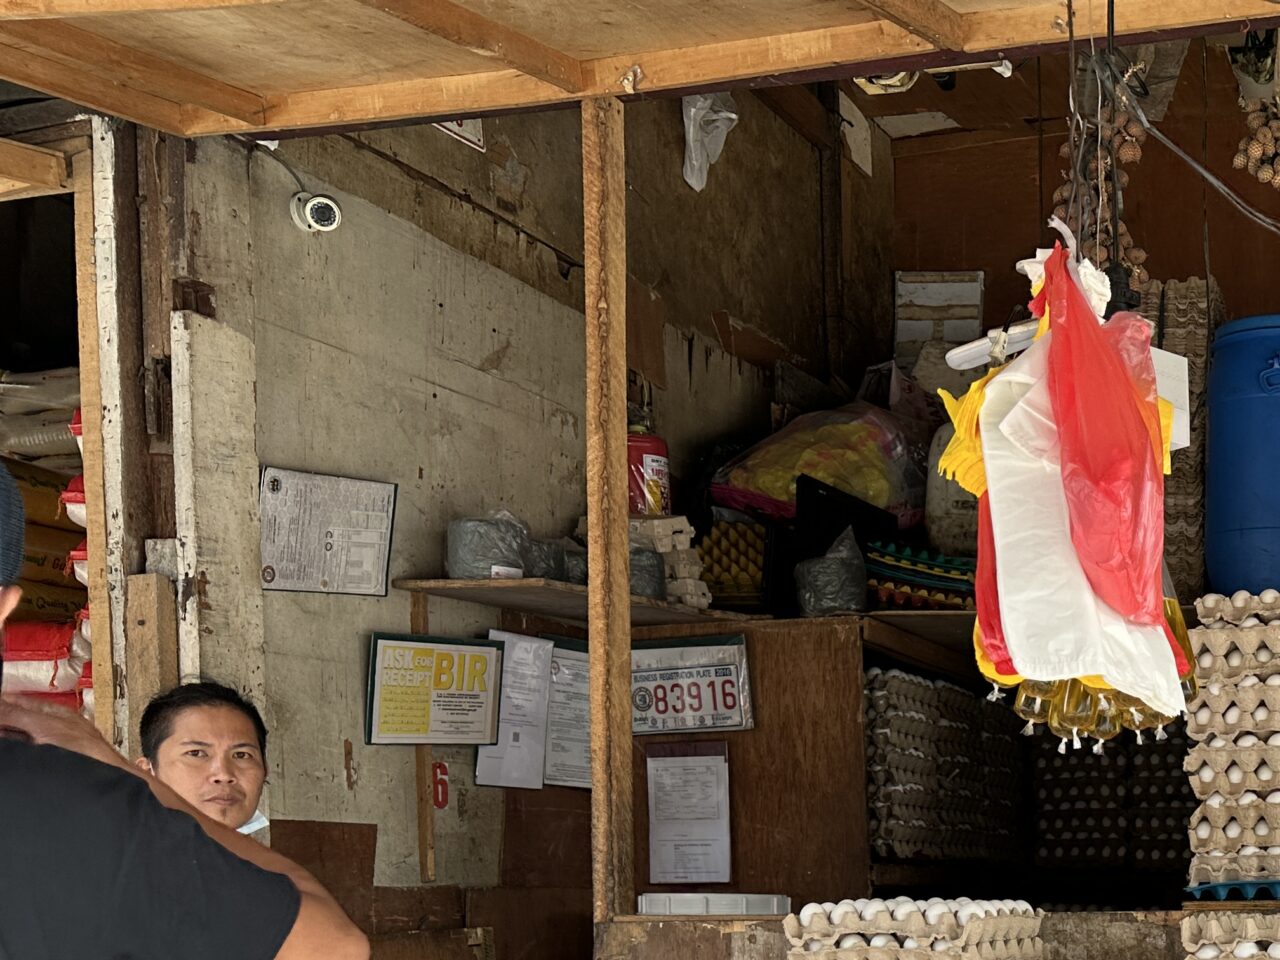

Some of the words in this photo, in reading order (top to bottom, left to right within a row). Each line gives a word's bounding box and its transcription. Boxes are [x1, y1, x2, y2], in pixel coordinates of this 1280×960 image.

[383, 649, 414, 670] ASK
[433, 652, 488, 692] BIR
[382, 670, 432, 688] RECEIPT
[633, 673, 658, 683] BUSINESS
[659, 670, 694, 681] REGISTRATION
[696, 669, 712, 678] PLATE
[653, 679, 737, 715] 83916
[432, 761, 449, 809] 6
